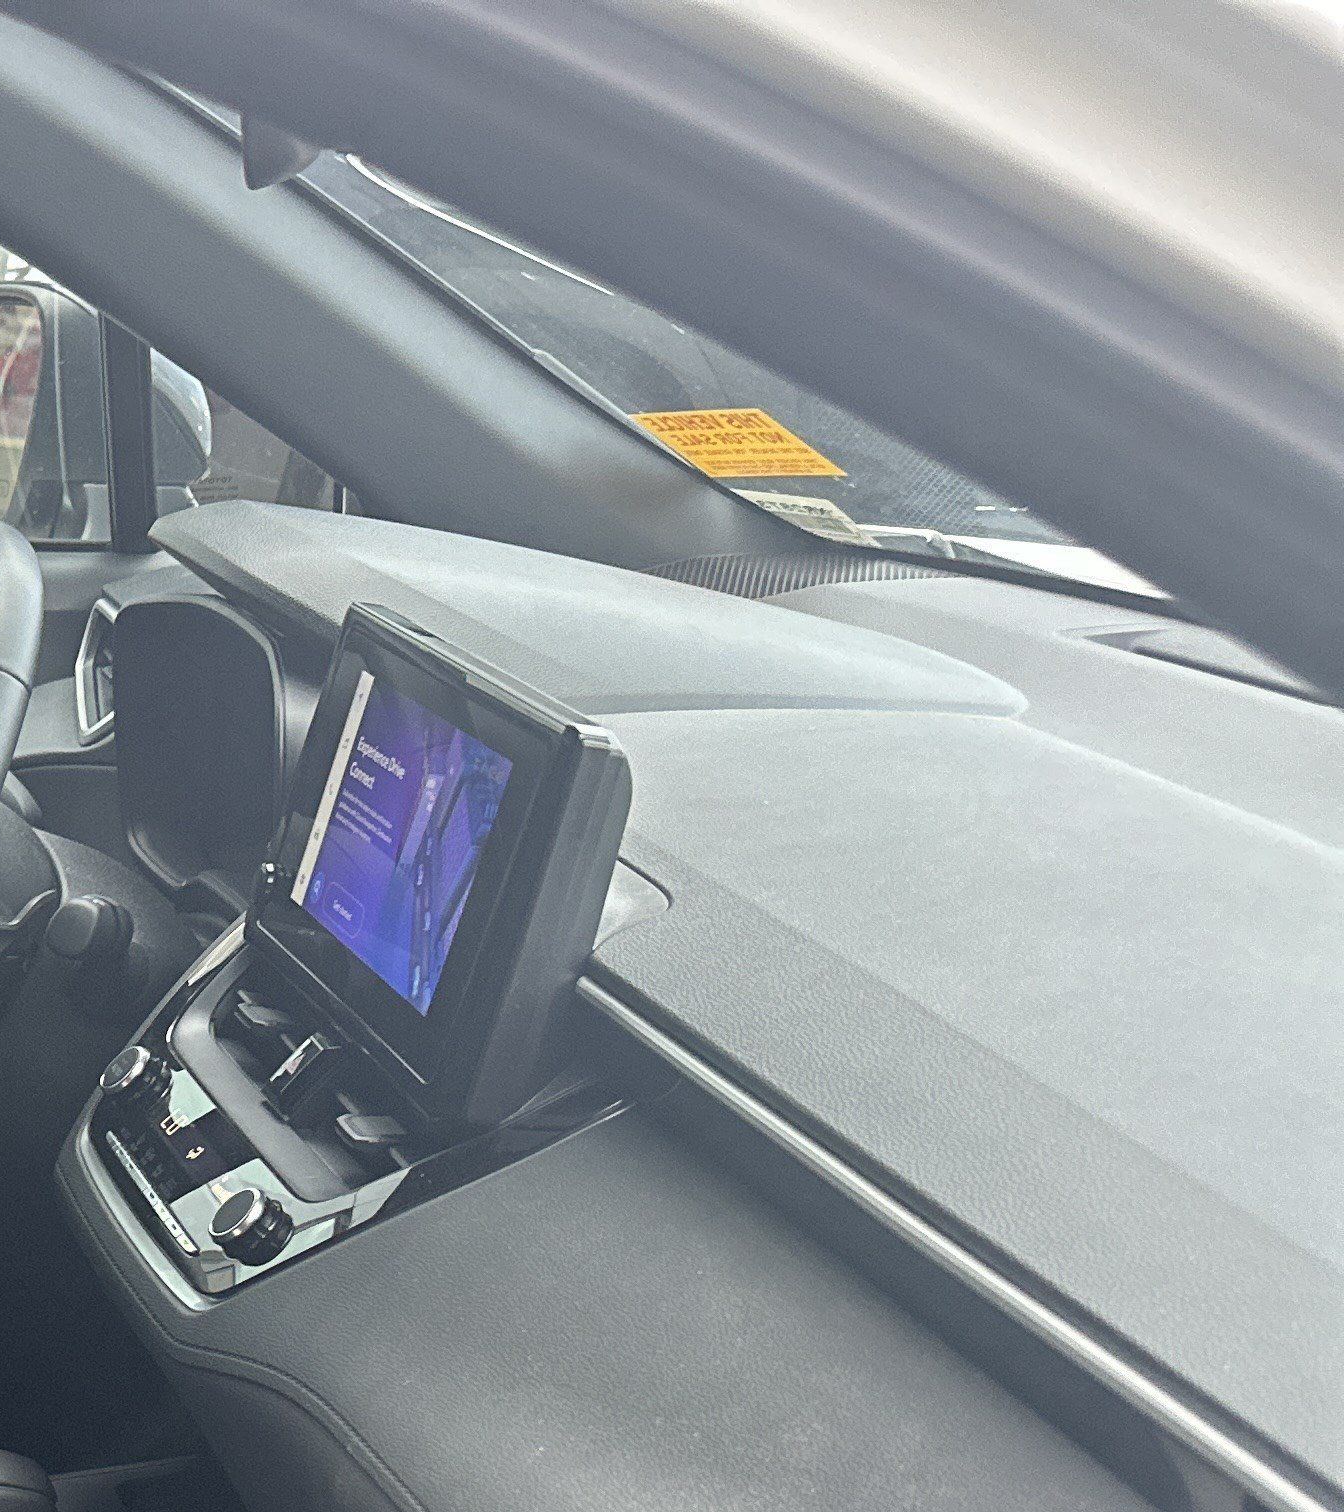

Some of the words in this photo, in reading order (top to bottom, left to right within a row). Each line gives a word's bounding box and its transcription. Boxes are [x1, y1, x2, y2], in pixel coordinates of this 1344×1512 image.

[349, 761, 375, 790] Connect
[357, 736, 390, 769] Experience
[387, 757, 406, 780] Drive
